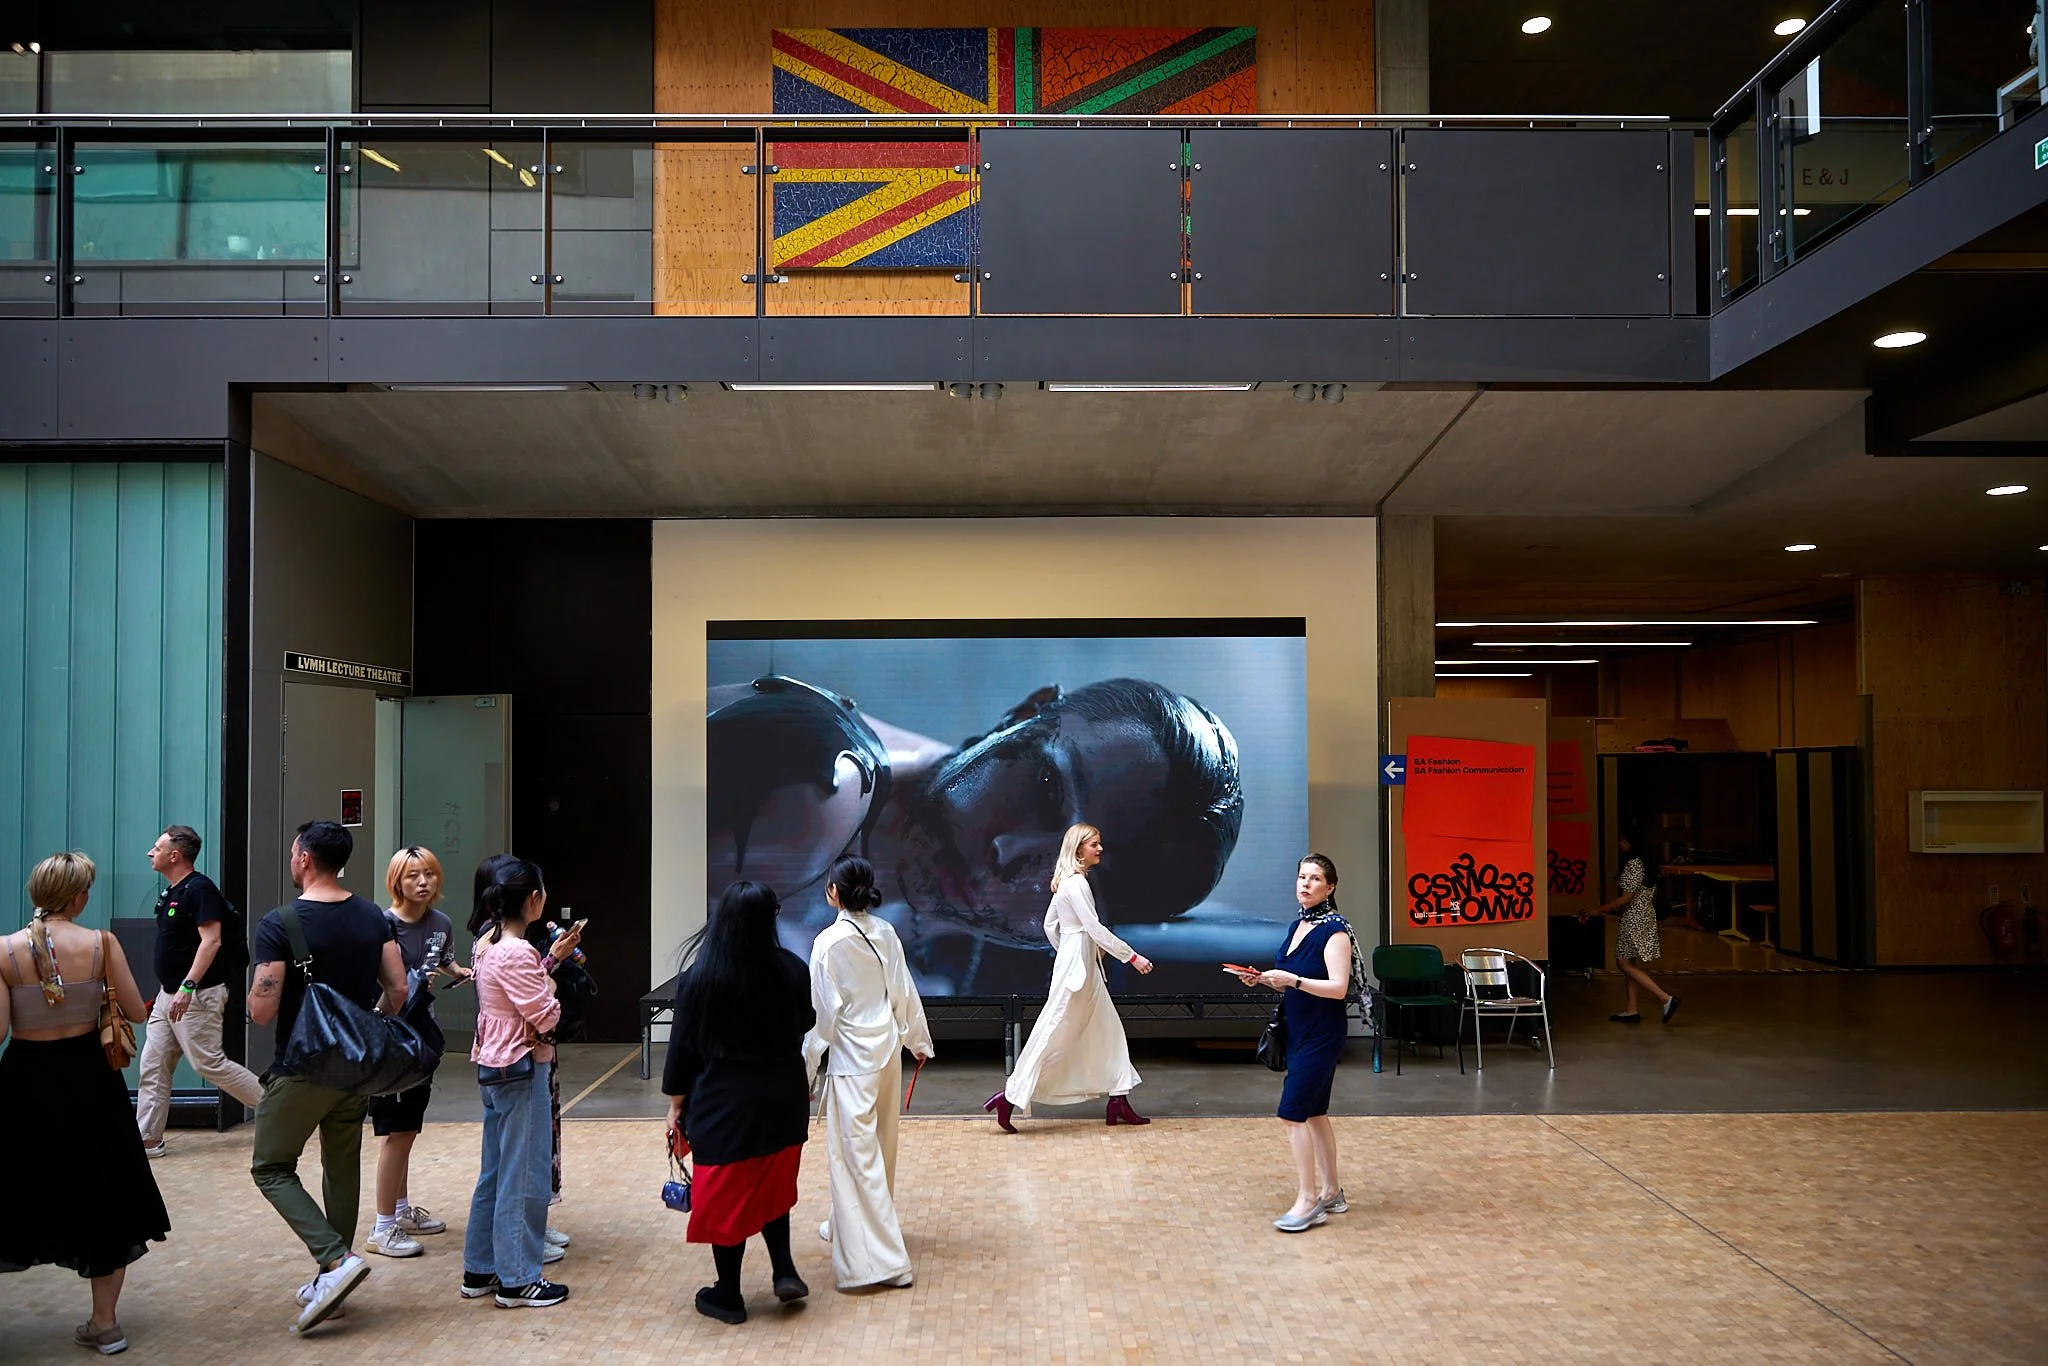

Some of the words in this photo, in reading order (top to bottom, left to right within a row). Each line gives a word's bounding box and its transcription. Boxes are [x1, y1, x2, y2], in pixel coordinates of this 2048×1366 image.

[298, 656, 326, 672] LVMH
[326, 661, 366, 678] LECTURE
[366, 667, 402, 684] THEATRE
[1414, 758, 1426, 766] BA
[1428, 758, 1461, 766] Fashion
[1414, 767, 1426, 775] BA
[1428, 767, 1460, 775] Fashion
[1462, 766, 1524, 775] Communication
